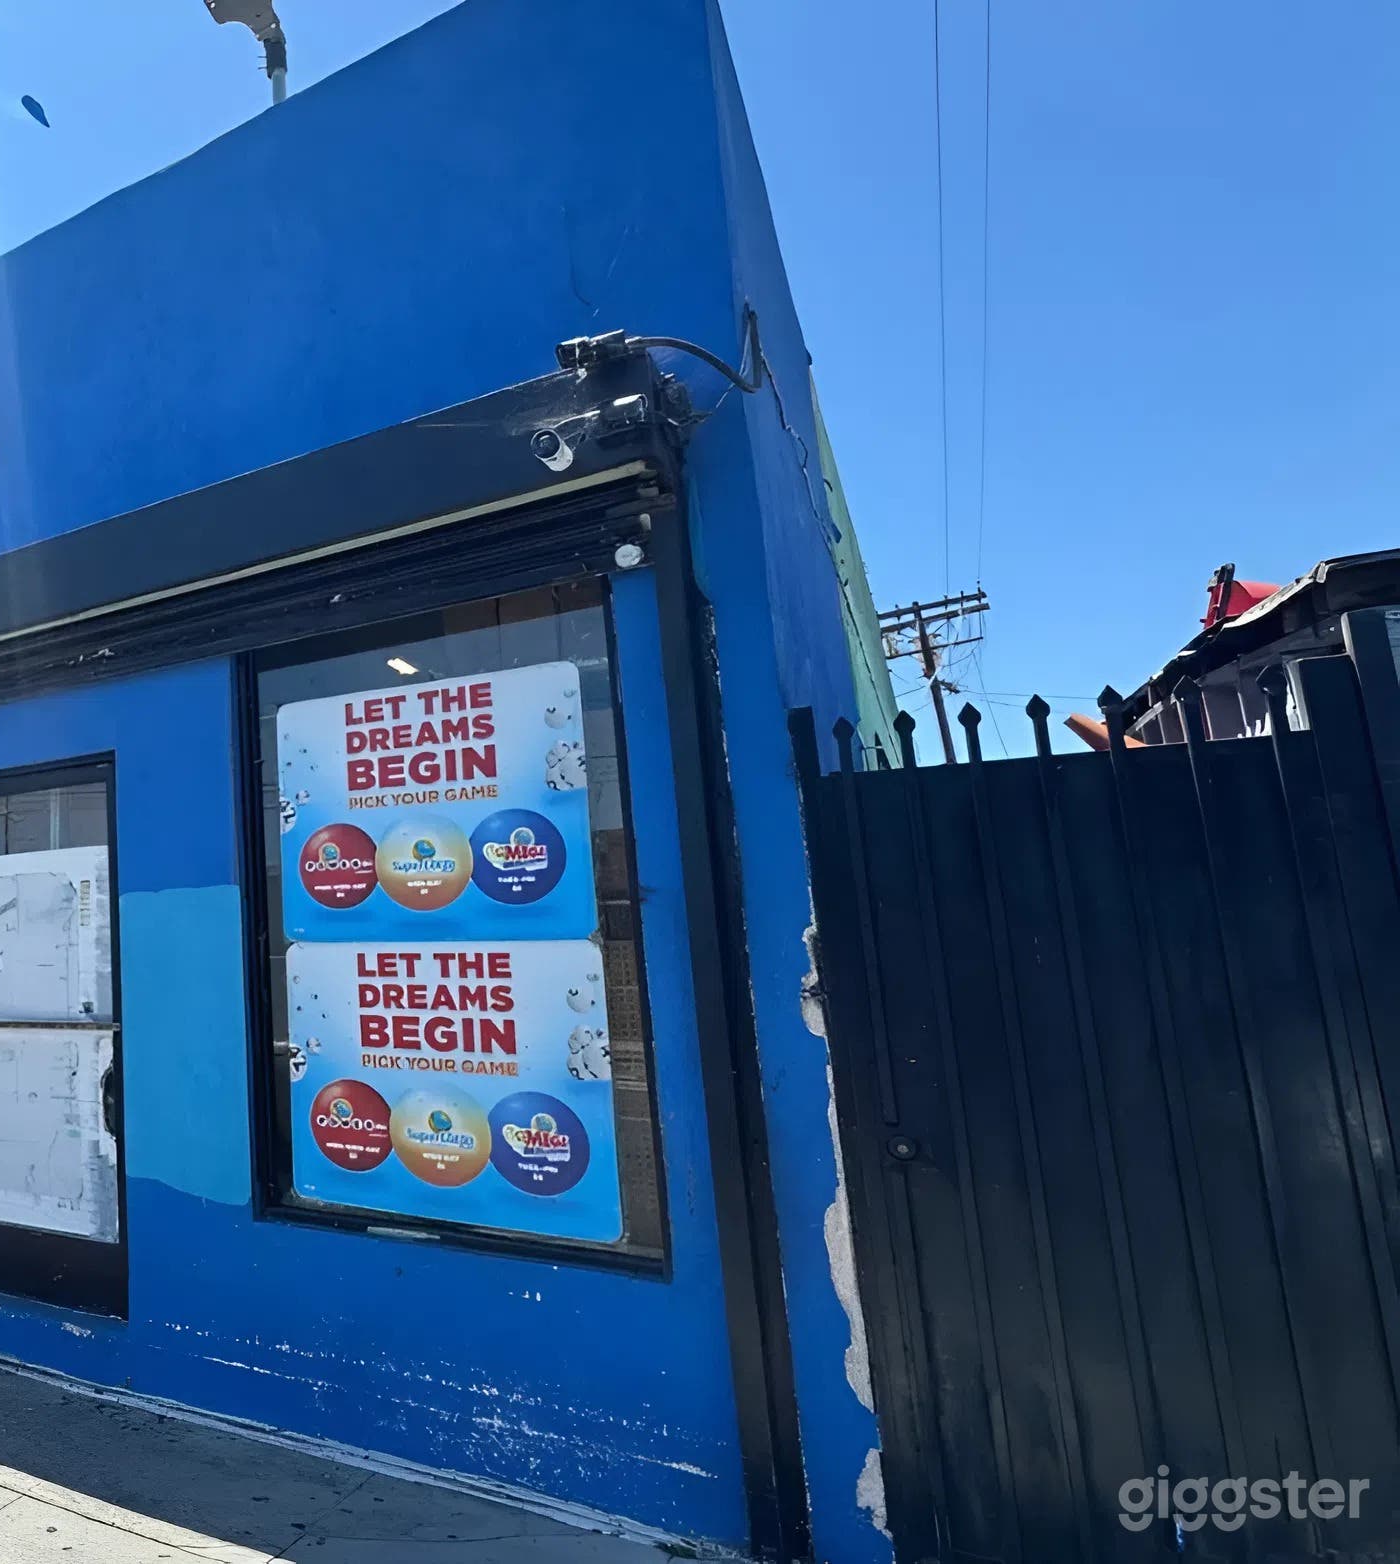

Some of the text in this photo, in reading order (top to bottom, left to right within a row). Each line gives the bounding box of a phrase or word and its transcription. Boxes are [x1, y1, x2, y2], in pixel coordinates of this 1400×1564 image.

[344, 681, 493, 726] LET THE
[346, 713, 496, 755] DREAMS
[347, 744, 498, 791] BEGIN
[391, 790, 440, 806] YOUR
[444, 784, 499, 802] GAME
[357, 952, 512, 979] LET THE
[358, 984, 515, 1012] DREAMS
[359, 1014, 517, 1055] BEGIN
[405, 1056, 457, 1073] YOUR
